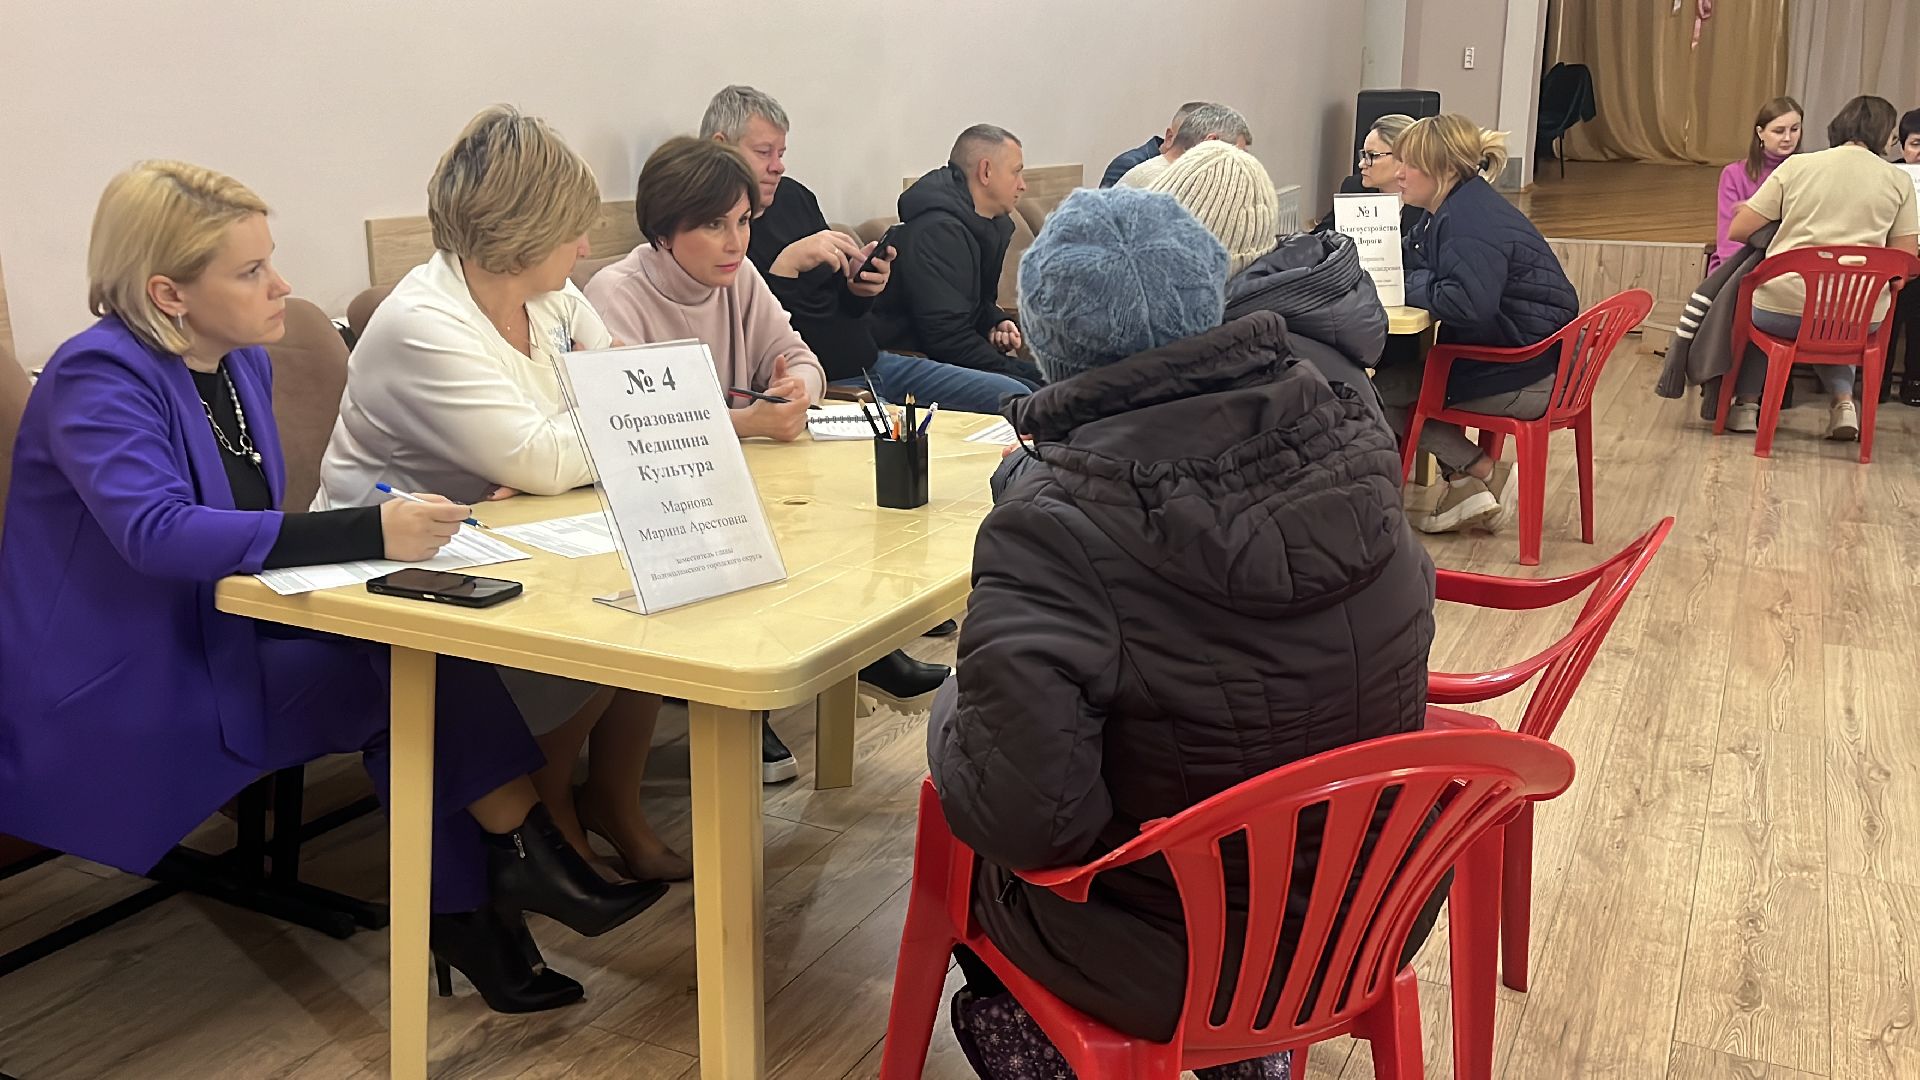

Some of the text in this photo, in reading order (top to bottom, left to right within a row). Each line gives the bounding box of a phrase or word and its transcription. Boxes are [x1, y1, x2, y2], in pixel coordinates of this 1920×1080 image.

[1356, 206, 1378, 217] № 1
[622, 366, 676, 395] № 4
[609, 408, 711, 432] Образование
[627, 434, 709, 456] Медицина
[638, 460, 714, 483] Культура
[638, 514, 748, 542] Марина Арестовна
